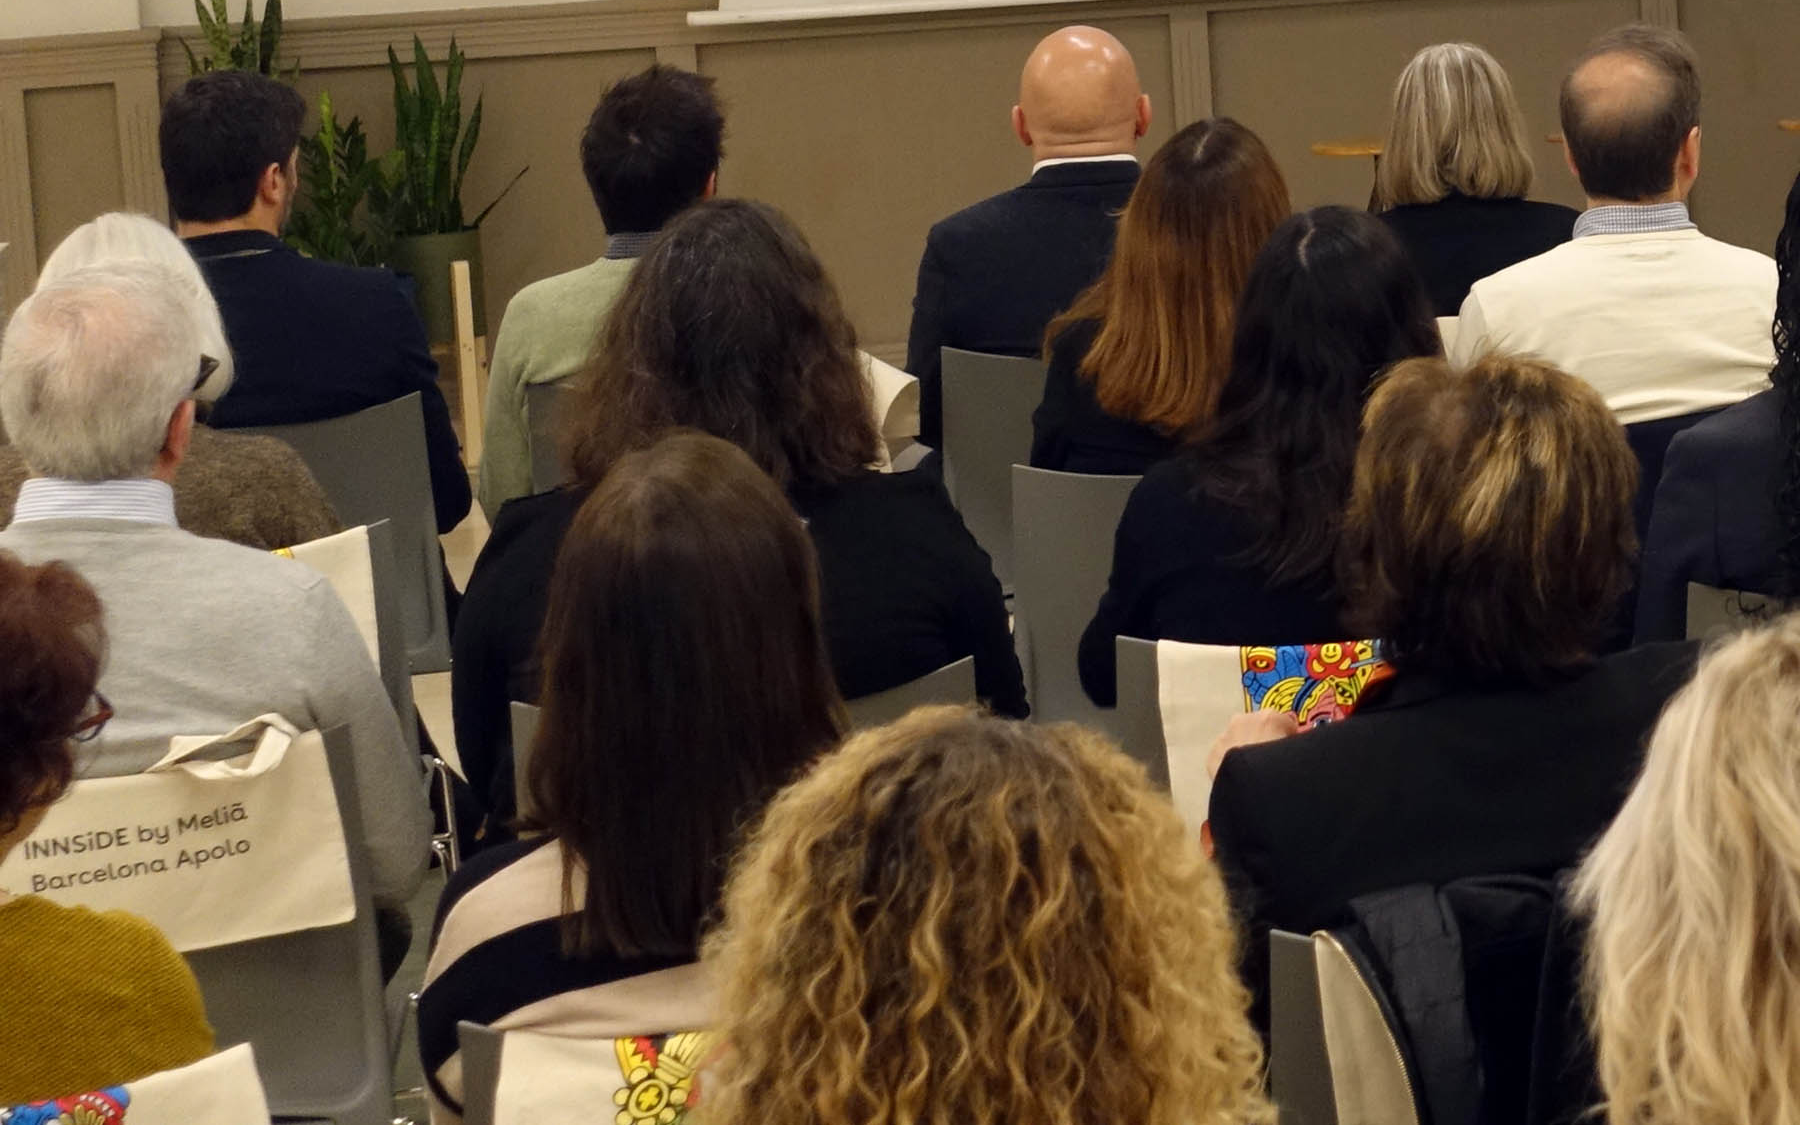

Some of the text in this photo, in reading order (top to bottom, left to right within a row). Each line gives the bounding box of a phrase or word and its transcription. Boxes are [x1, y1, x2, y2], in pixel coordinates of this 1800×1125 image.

[24, 827, 129, 860] INNSiDE
[137, 825, 170, 845] by
[31, 837, 251, 893] Barcelona Apolo
